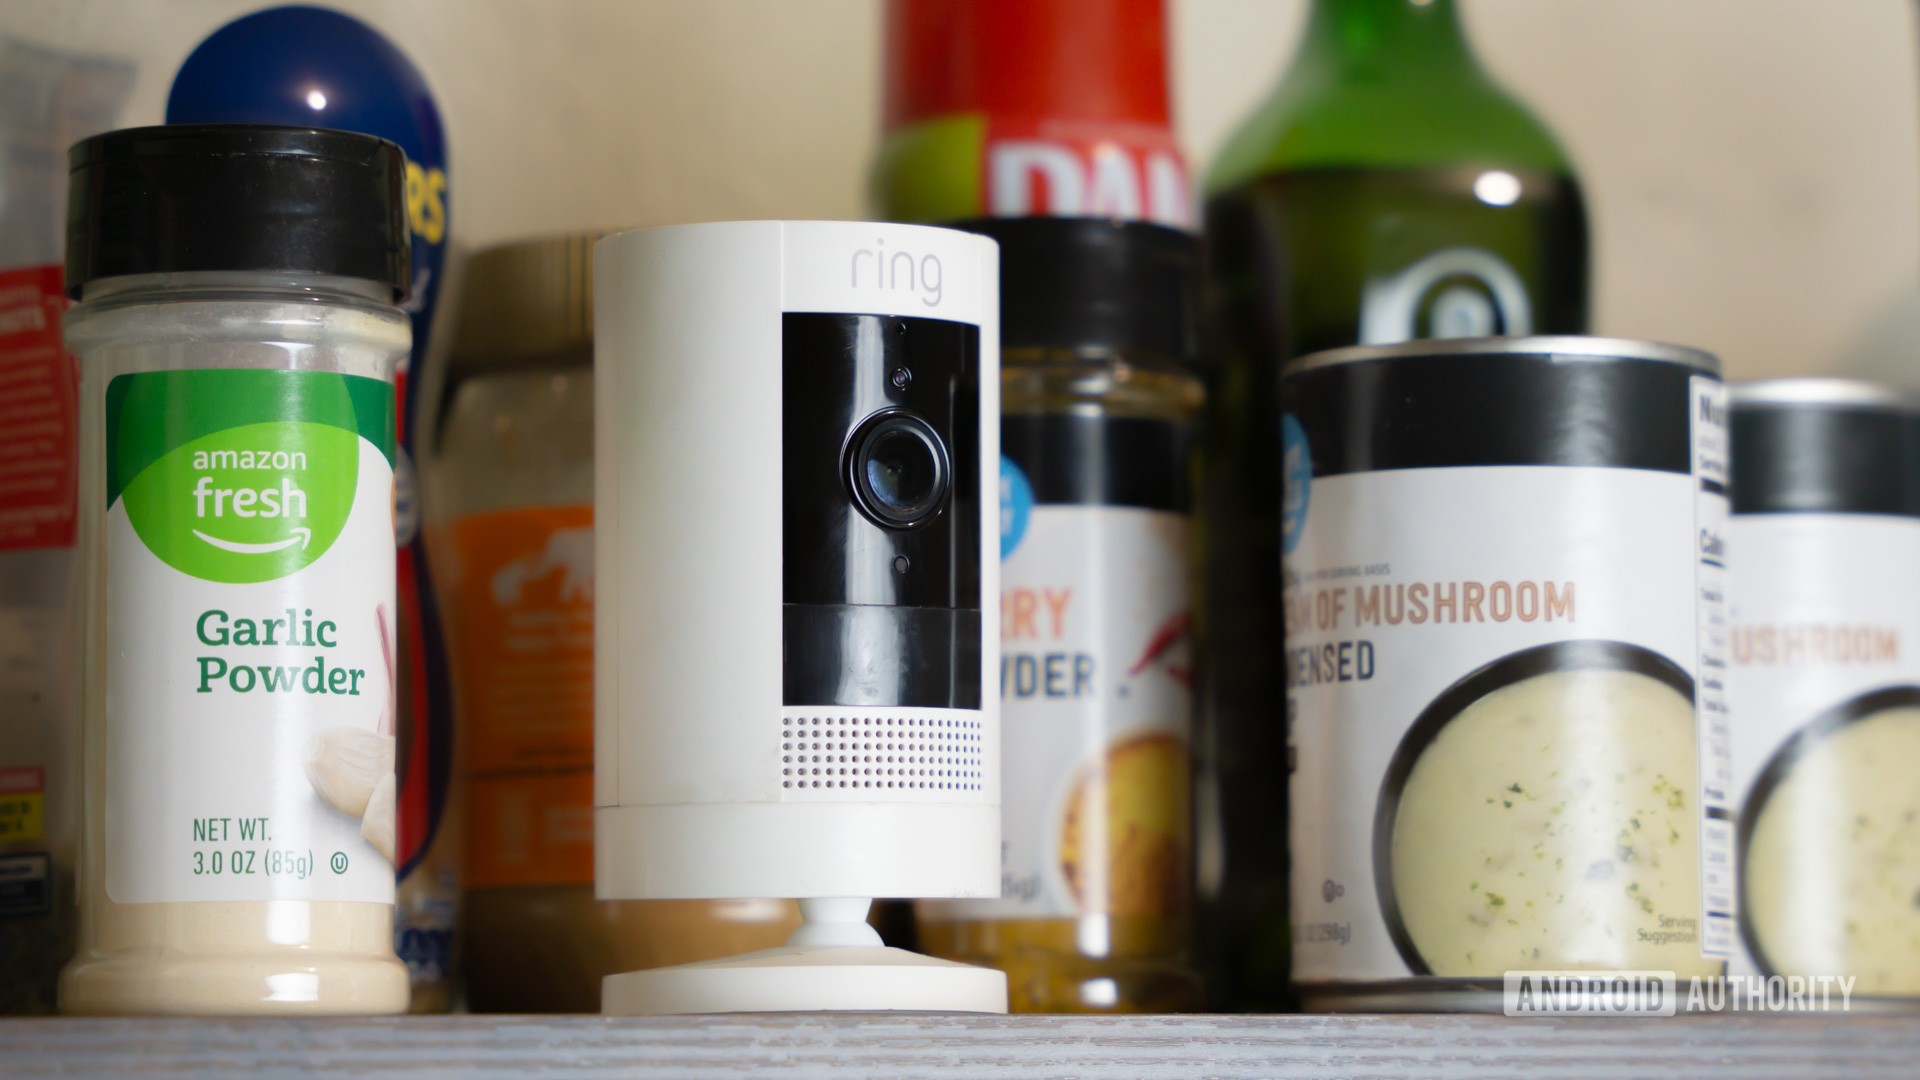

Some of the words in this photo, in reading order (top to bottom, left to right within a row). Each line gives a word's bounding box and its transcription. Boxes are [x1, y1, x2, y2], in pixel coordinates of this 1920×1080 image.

[851, 237, 942, 307] ring
[193, 450, 307, 470] amazon
[193, 476, 307, 518] fresh
[1316, 587, 1346, 631] OF
[1354, 580, 1575, 628] MUSHROOM
[196, 608, 337, 648] Garlic
[196, 656, 366, 696] Powder
[193, 818, 231, 842] NET
[239, 817, 273, 842] WT.
[193, 850, 223, 875] 3.0
[231, 850, 256, 875] OZ
[264, 849, 314, 880] (85g)
[1636, 927, 1697, 945] Suggestion
[1657, 914, 1696, 932] Serving
